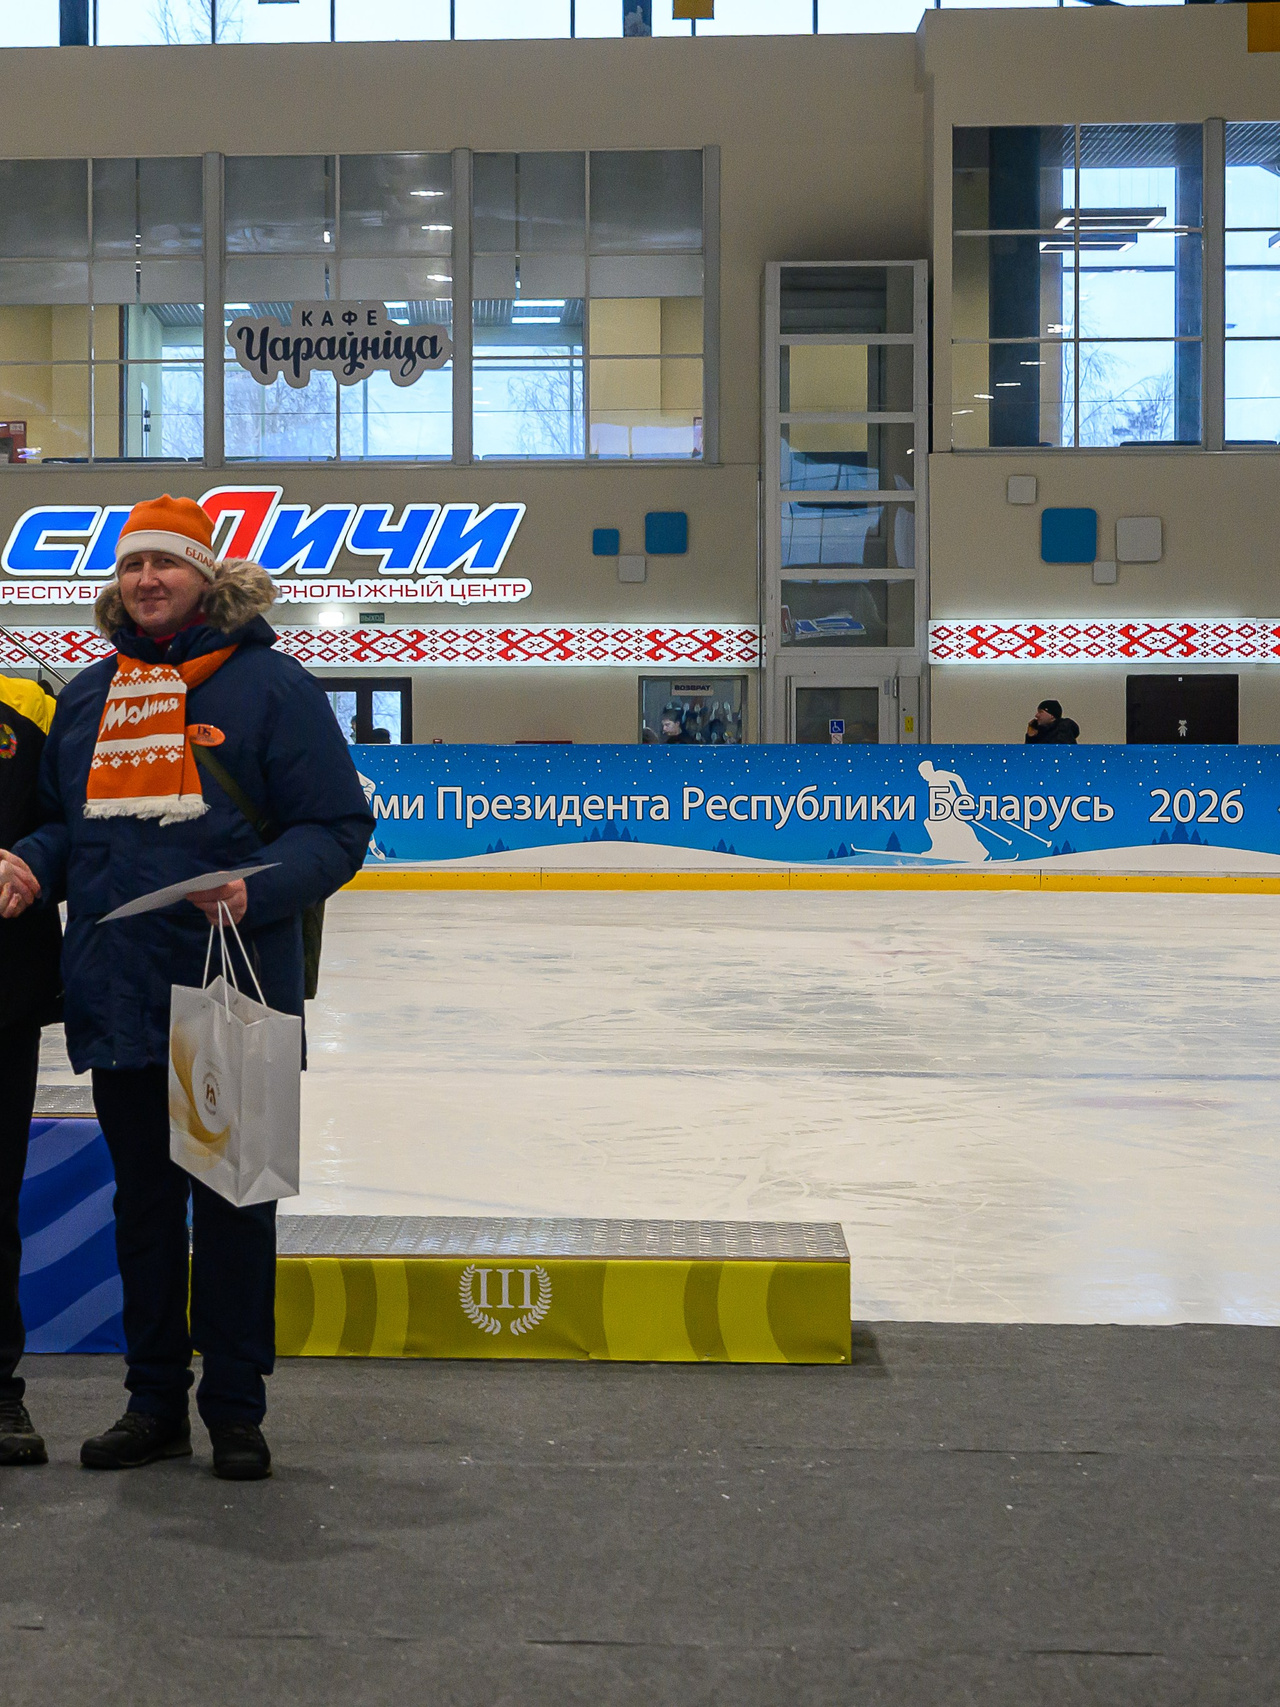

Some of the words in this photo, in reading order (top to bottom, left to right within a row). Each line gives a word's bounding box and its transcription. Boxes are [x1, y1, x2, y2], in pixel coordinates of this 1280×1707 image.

[301, 310, 377, 326] КАФЕ
[236, 326, 443, 378] Чараўніца
[450, 583, 526, 599] ЦЕНТР
[436, 786, 670, 829] Президента
[682, 785, 916, 830] Республики
[928, 785, 1116, 831] Беларусь
[1148, 788, 1245, 823] 2026
[474, 1268, 537, 1309] III
